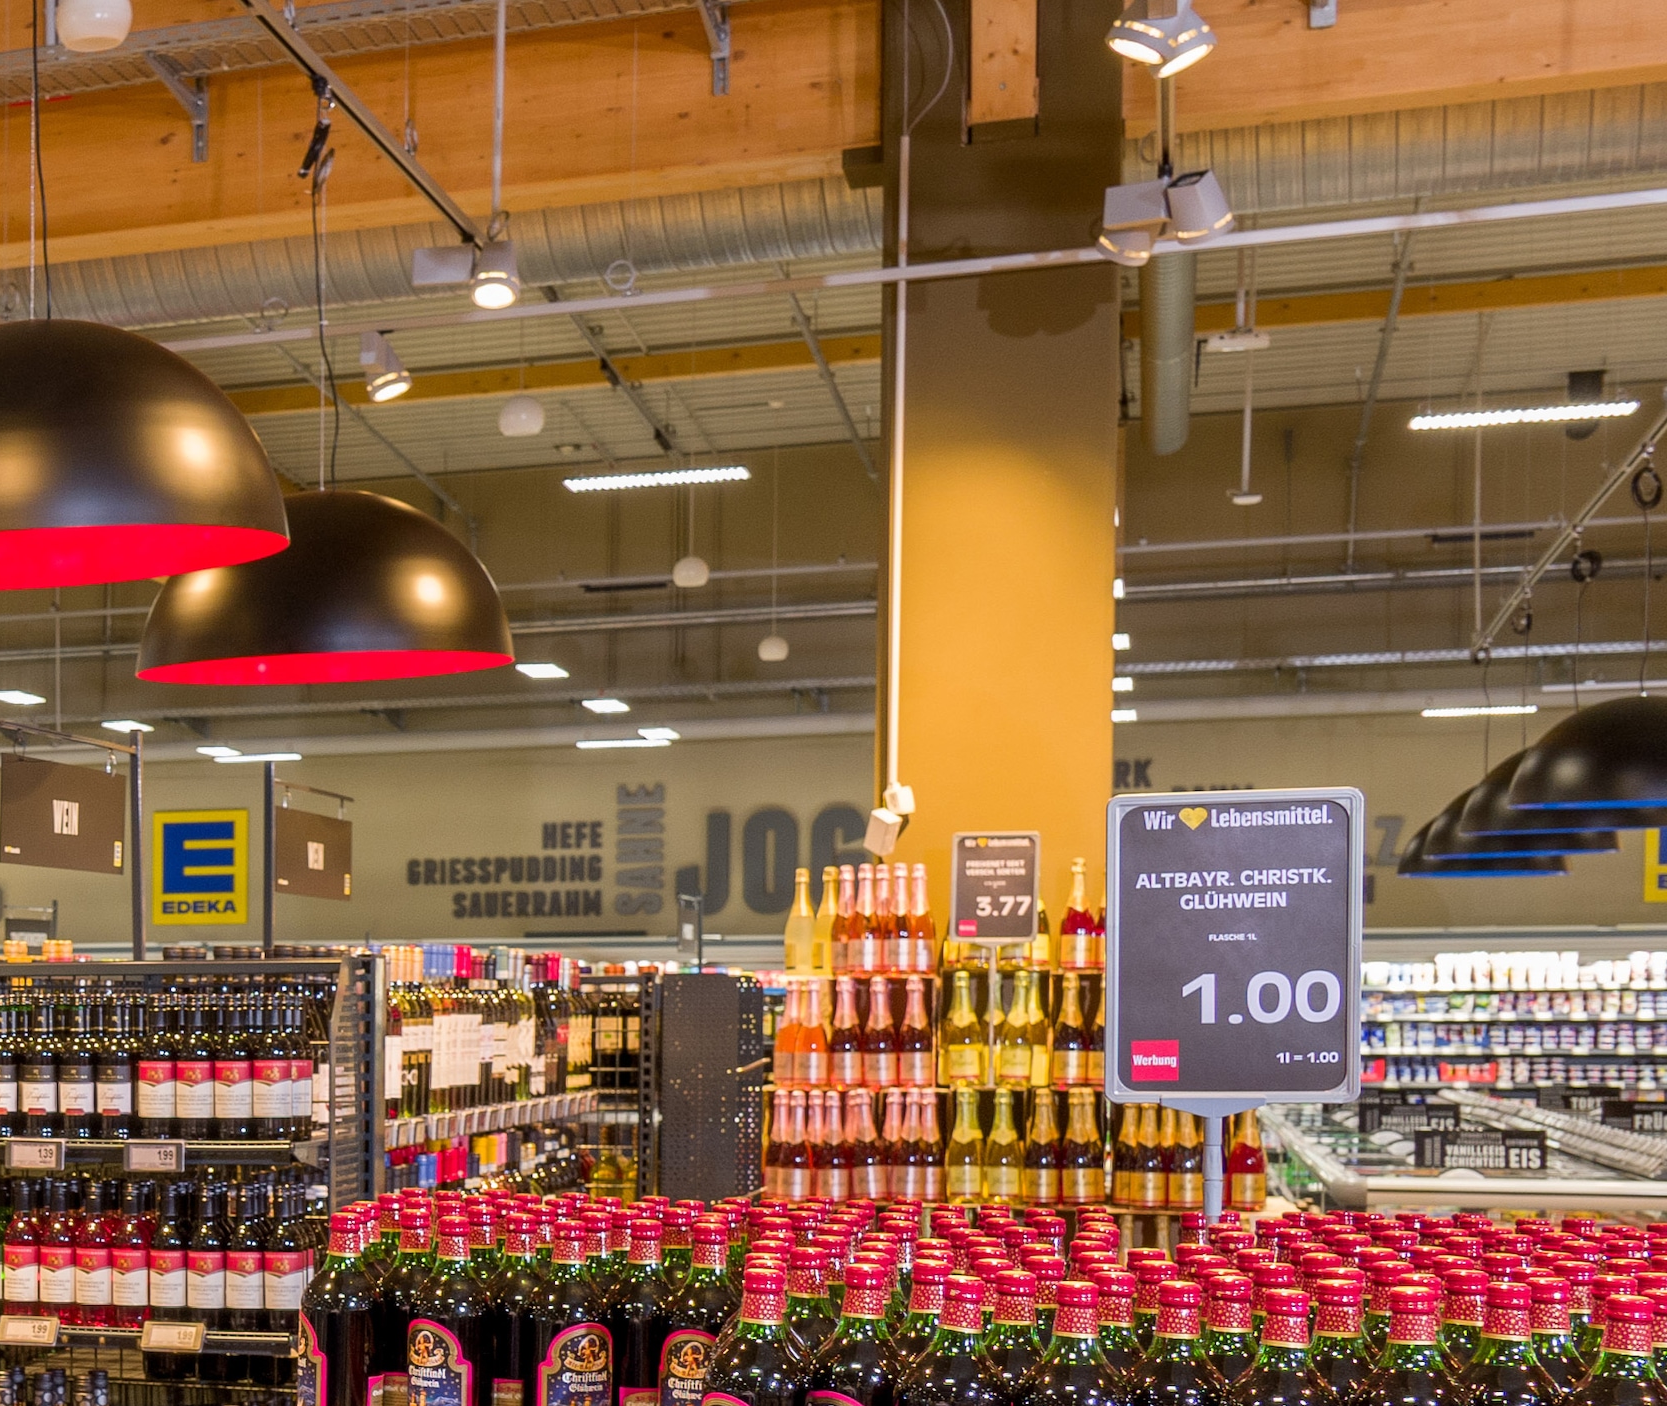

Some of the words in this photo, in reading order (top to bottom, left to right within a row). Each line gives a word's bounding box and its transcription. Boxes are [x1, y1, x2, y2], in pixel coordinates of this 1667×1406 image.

[1144, 810, 1175, 830] Wir
[1211, 805, 1333, 827] Lebensmittel.
[542, 822, 602, 849] HEFE
[616, 782, 664, 916] SAHNE
[407, 856, 602, 885] GRIESSPUDDING
[1136, 871, 1234, 889] ALTBAYR.
[1240, 868, 1332, 886] CHRISTK.
[163, 901, 236, 914] EDEKA
[453, 890, 602, 918] SAUERRAHM
[976, 896, 1032, 916] 3.77
[1180, 892, 1286, 910] GLÜHWEIN
[1209, 933, 1244, 941] FLASCHE
[1182, 970, 1341, 1025] 1.00
[1133, 1054, 1177, 1067] Werbung
[1307, 1052, 1338, 1063] 1.00
[1509, 1148, 1540, 1169] EIS
